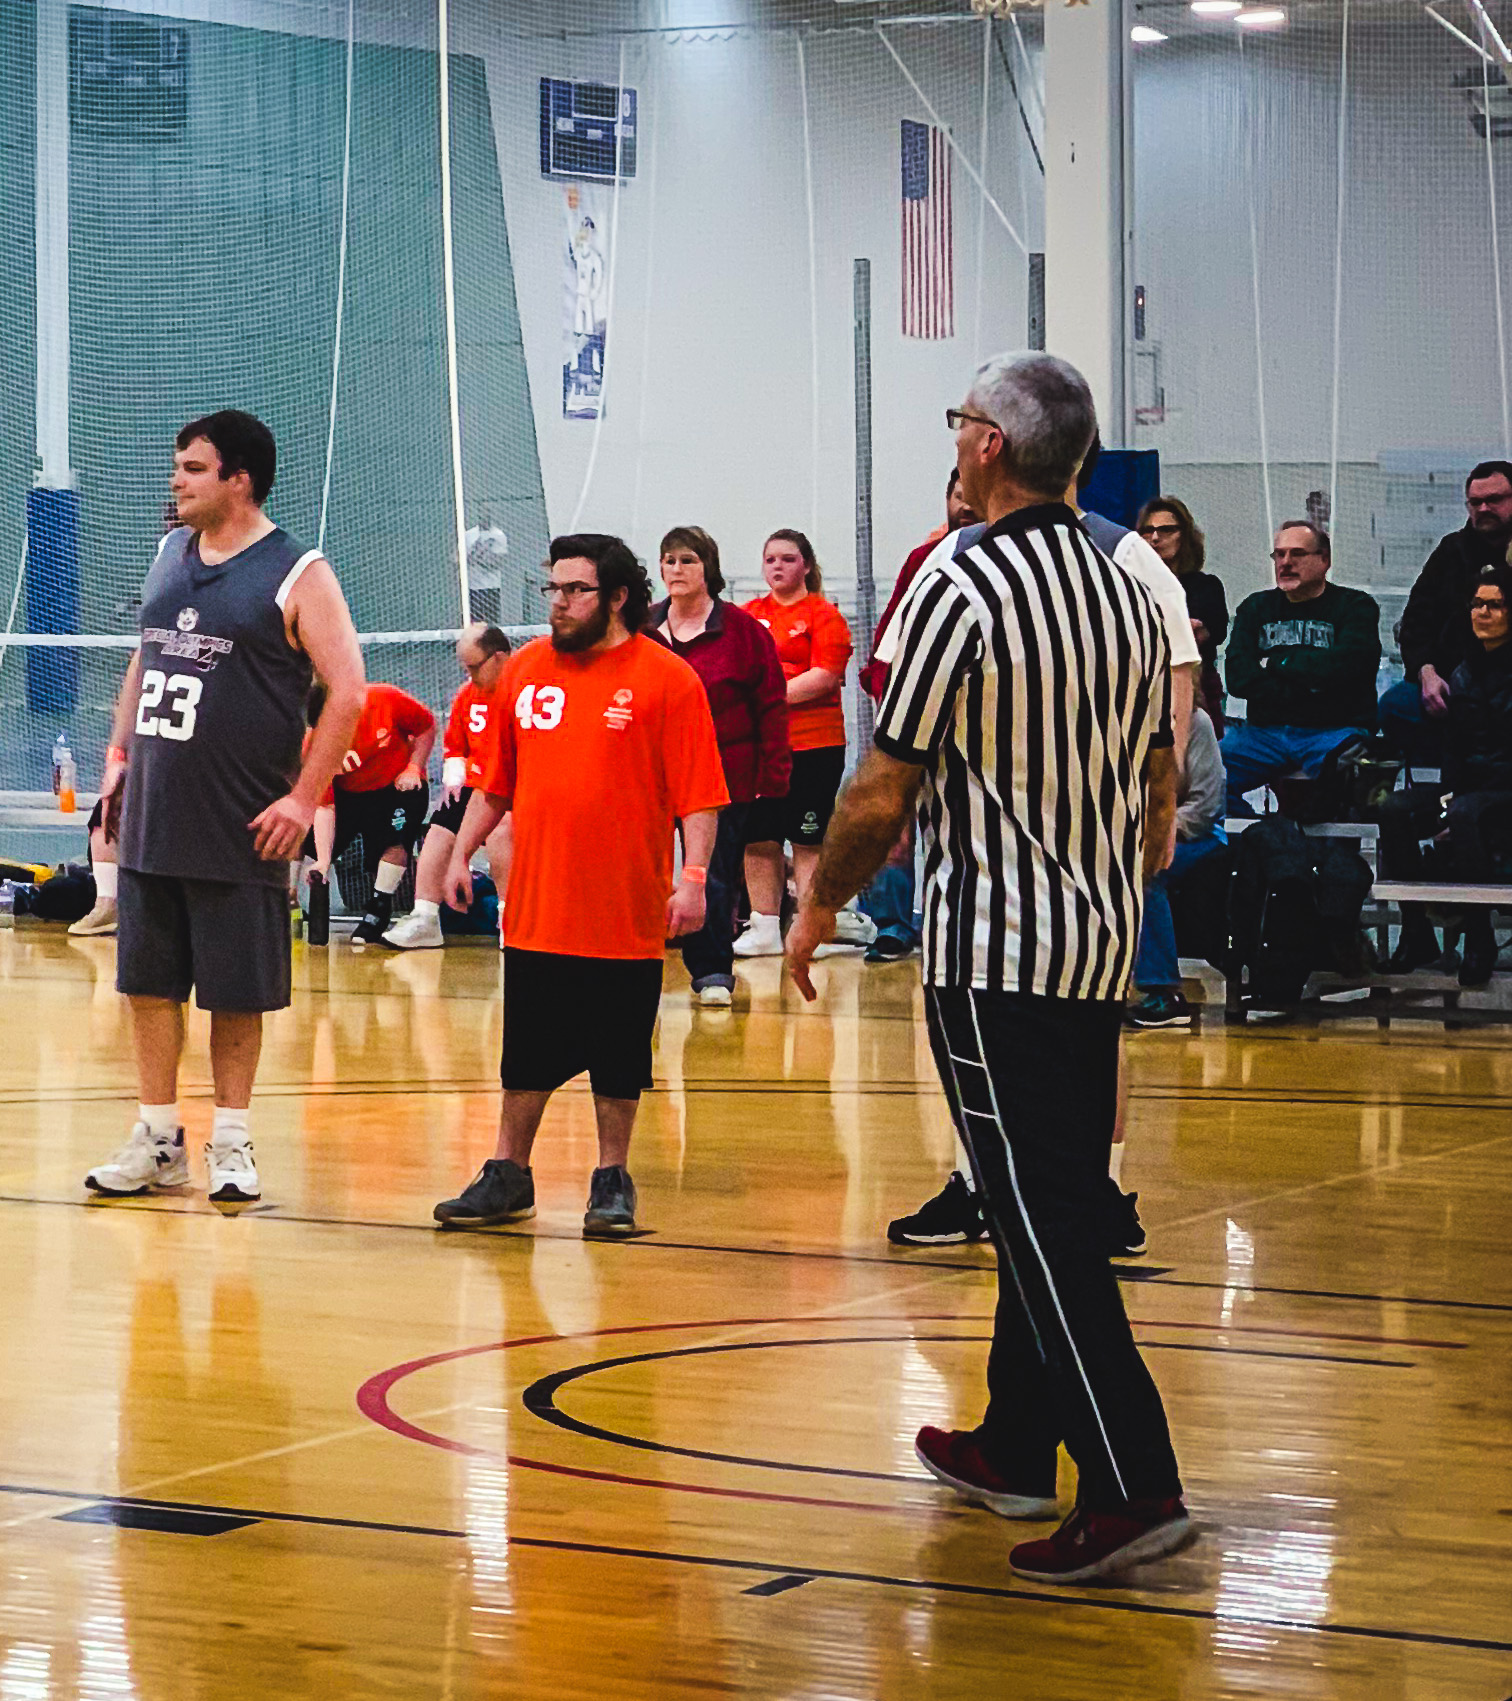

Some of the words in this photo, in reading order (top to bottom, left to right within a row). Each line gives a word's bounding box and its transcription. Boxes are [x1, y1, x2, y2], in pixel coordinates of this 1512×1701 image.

[135, 669, 204, 742] 23
[469, 703, 489, 733] 5
[515, 684, 566, 730] 43
